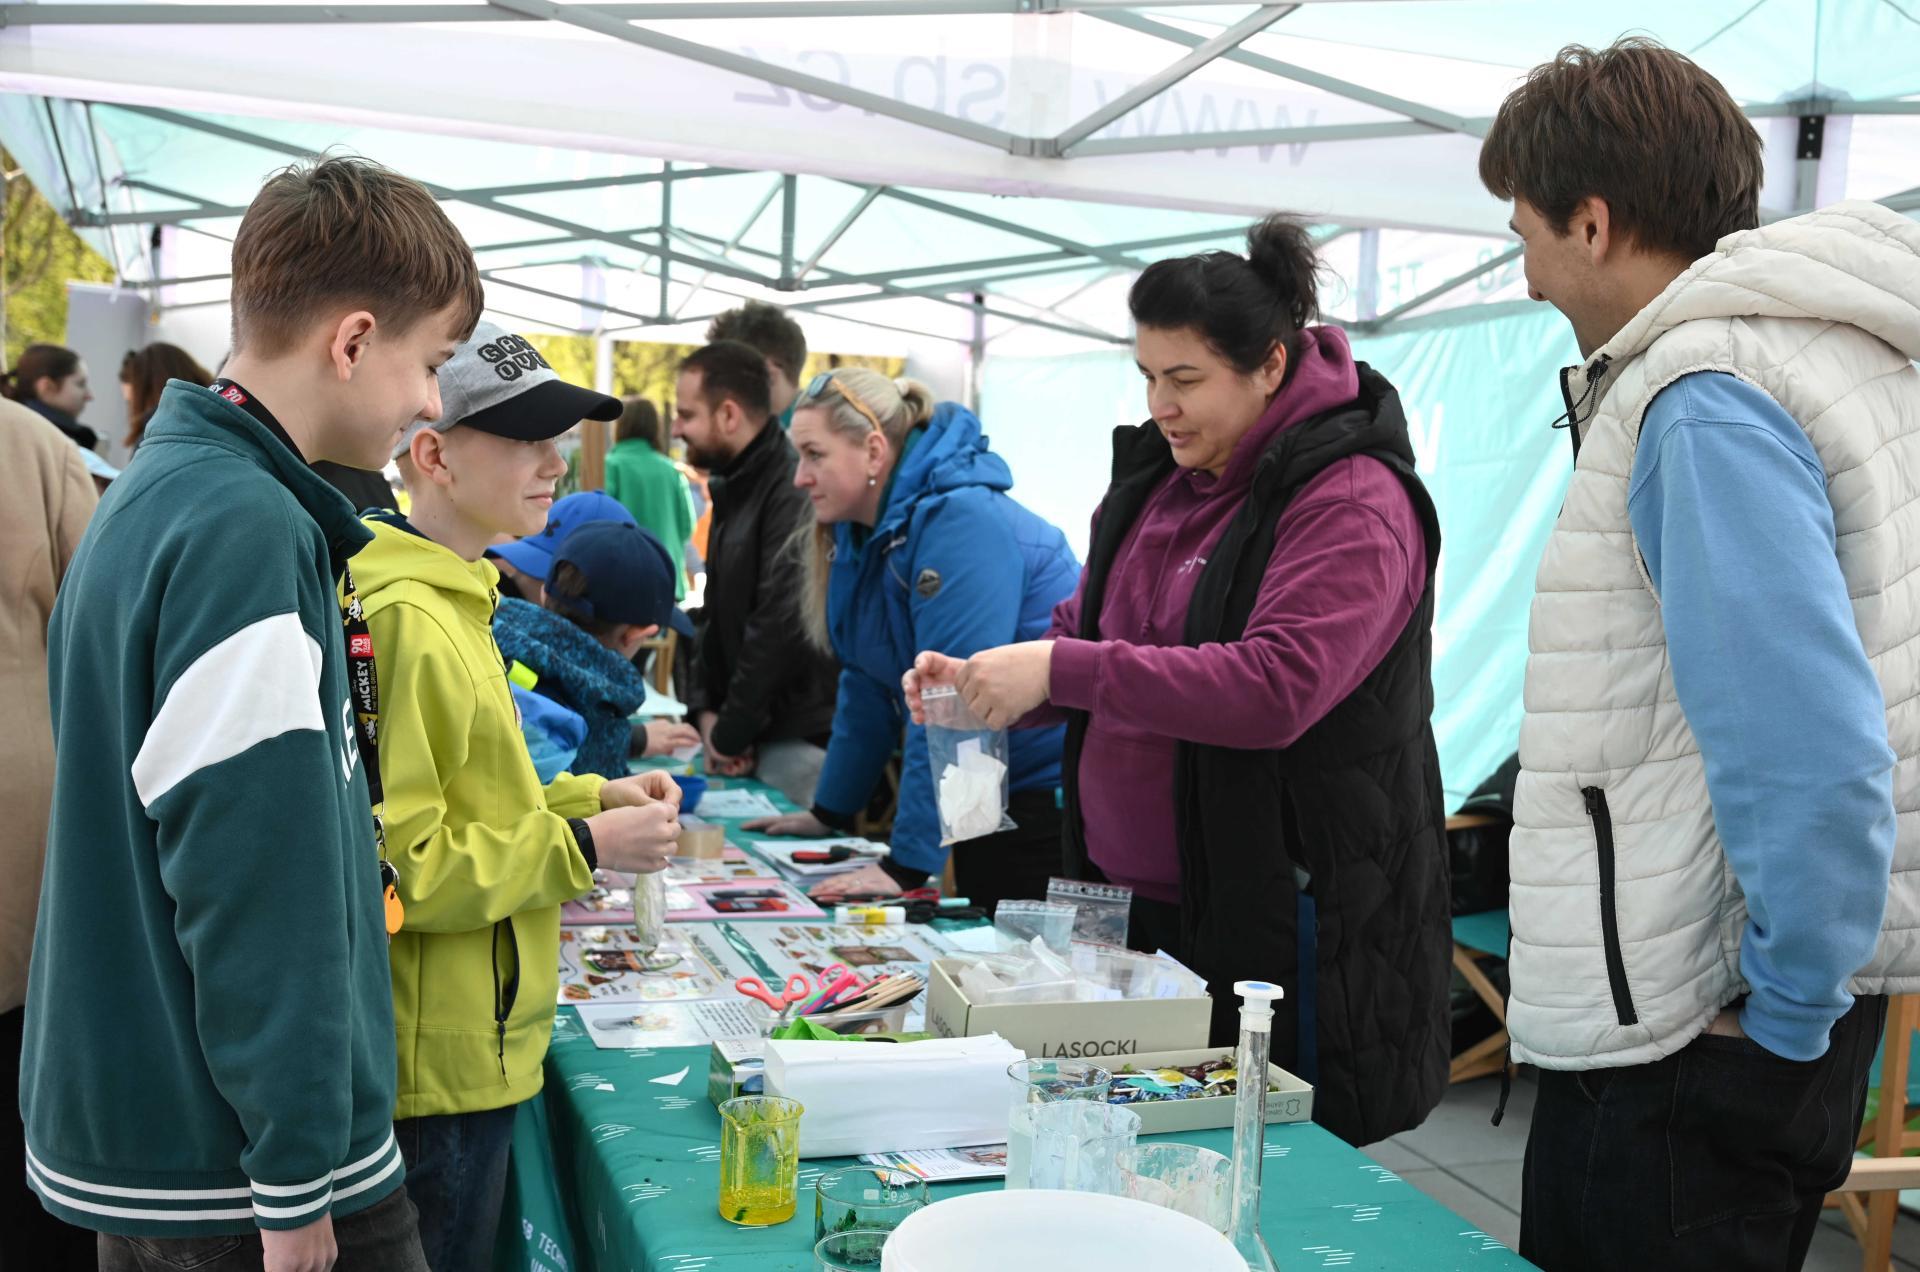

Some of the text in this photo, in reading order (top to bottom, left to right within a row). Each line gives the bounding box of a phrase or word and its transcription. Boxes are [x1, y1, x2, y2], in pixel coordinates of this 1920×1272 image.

[351, 638, 363, 654] 90
[356, 661, 373, 711] MICKEY
[1042, 1040, 1137, 1059] LASOCKI
